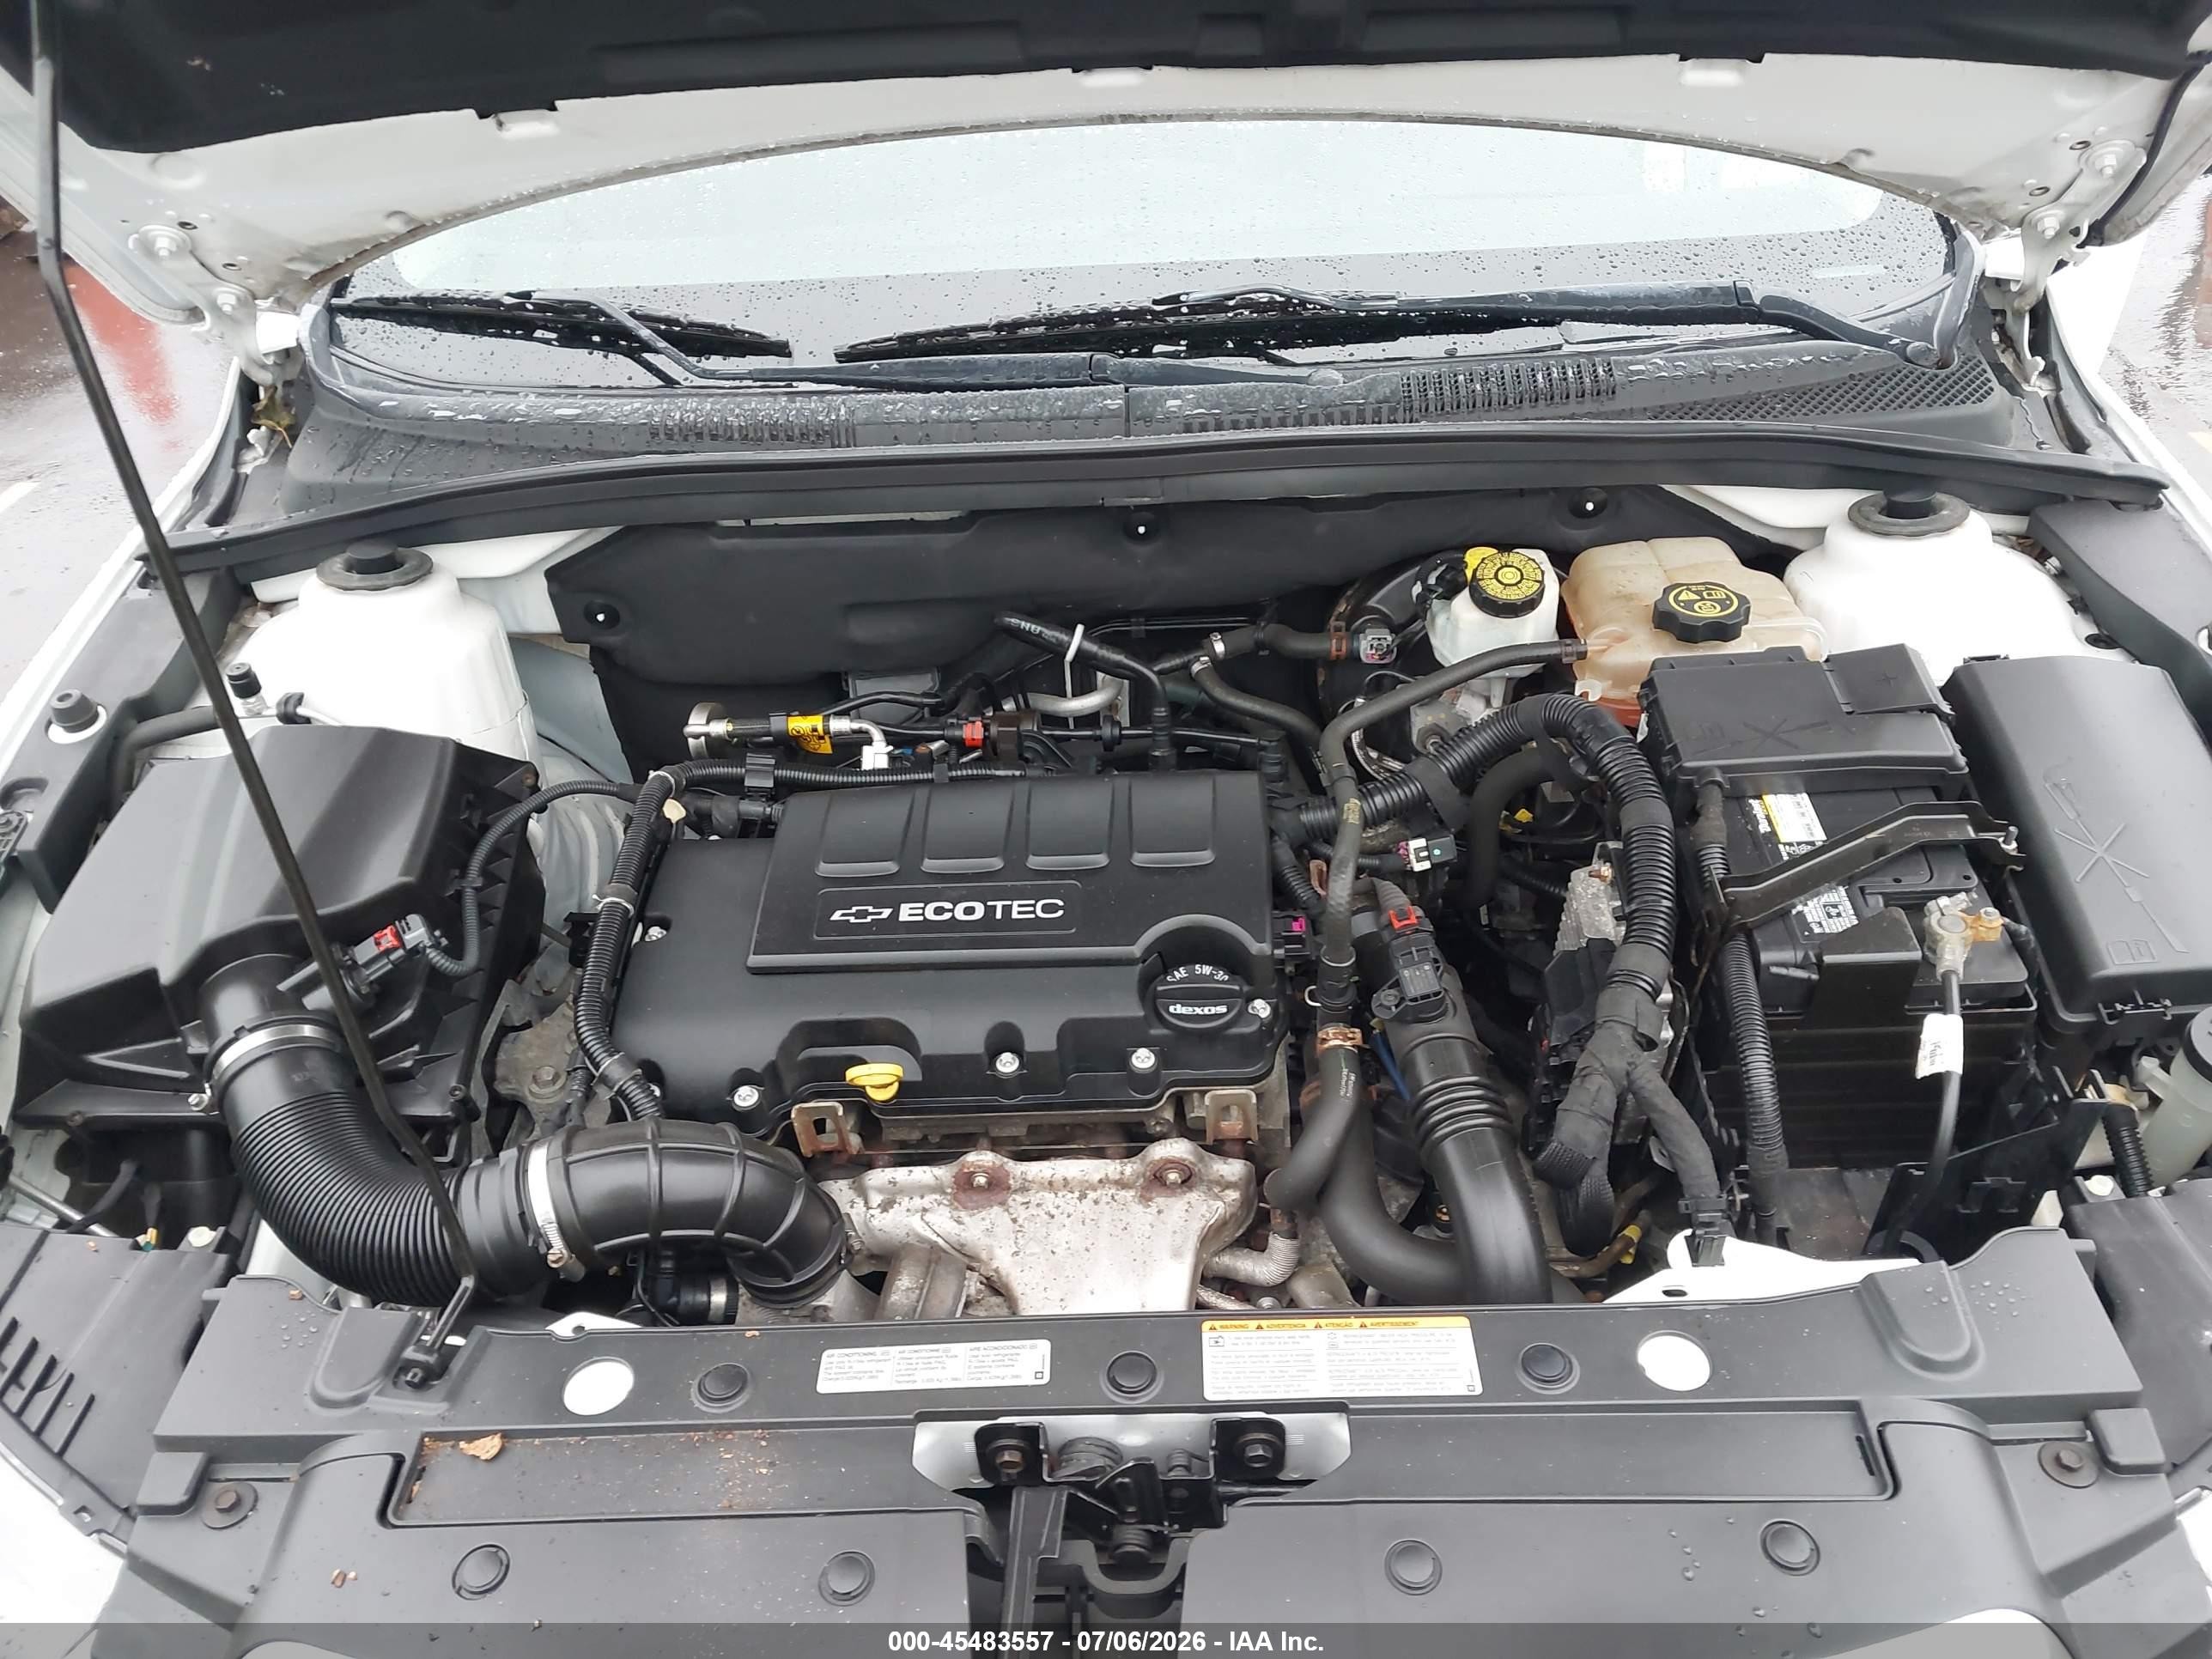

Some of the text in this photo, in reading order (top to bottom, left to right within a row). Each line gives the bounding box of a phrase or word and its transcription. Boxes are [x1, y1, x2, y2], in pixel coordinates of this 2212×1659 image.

[898, 898, 1065, 922] ECOTEC
[1166, 966, 1189, 982] SAE
[1169, 1003, 1228, 1015] dexos
